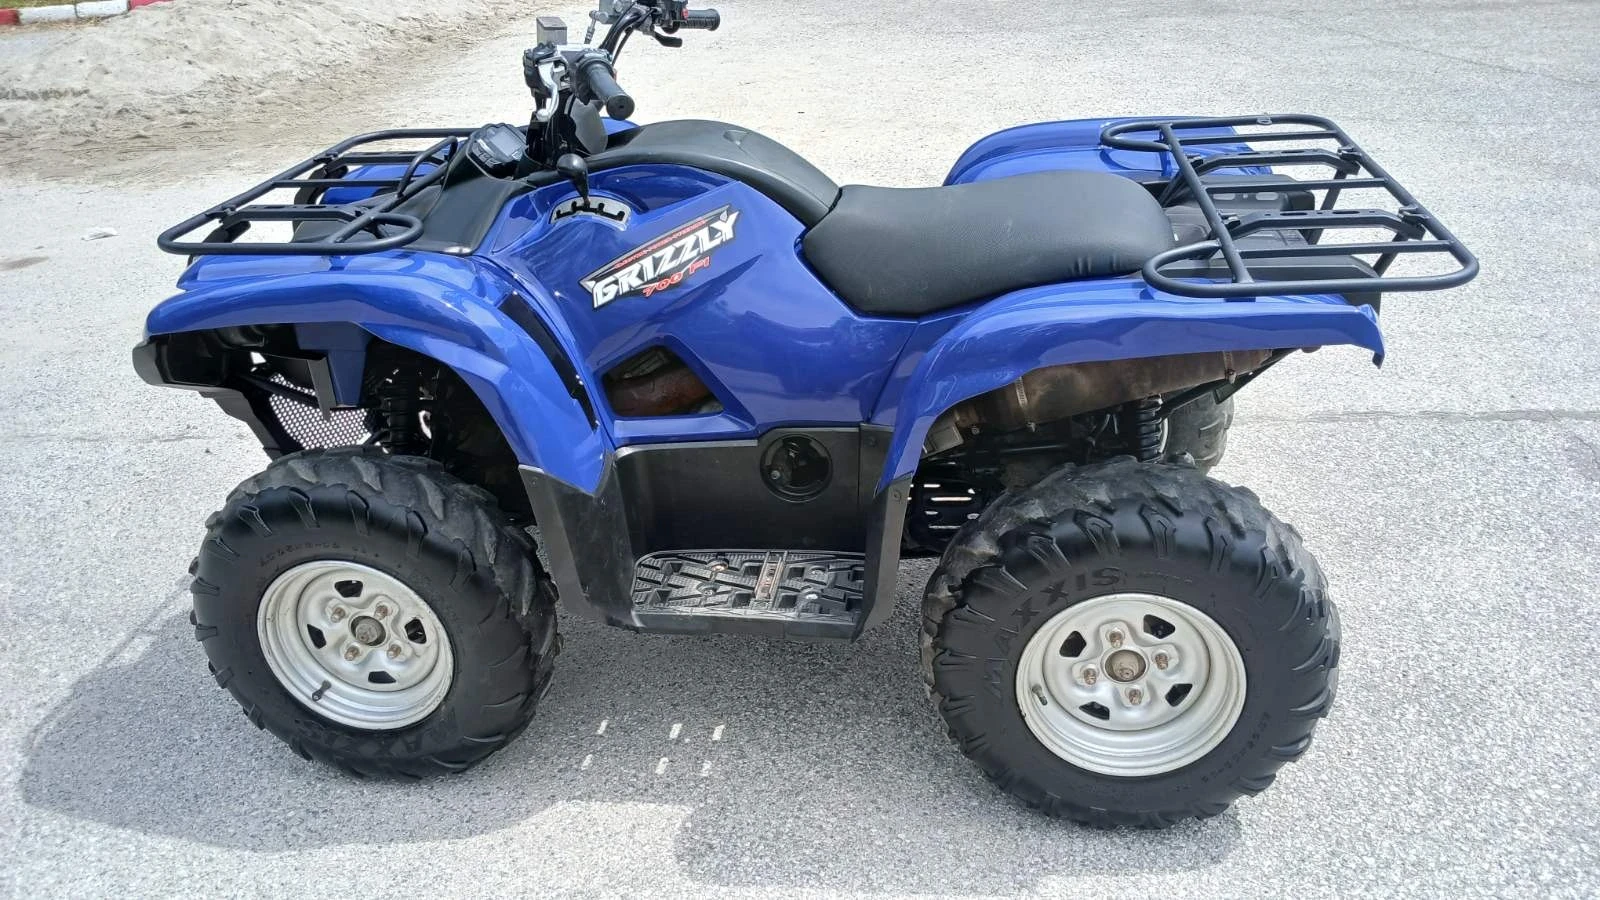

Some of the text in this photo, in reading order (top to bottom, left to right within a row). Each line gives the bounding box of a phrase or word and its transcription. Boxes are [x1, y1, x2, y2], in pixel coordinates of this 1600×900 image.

[592, 211, 739, 309] GRIZZLY
[642, 256, 711, 297] 700 FI
[983, 567, 1121, 699] MAXXIS
